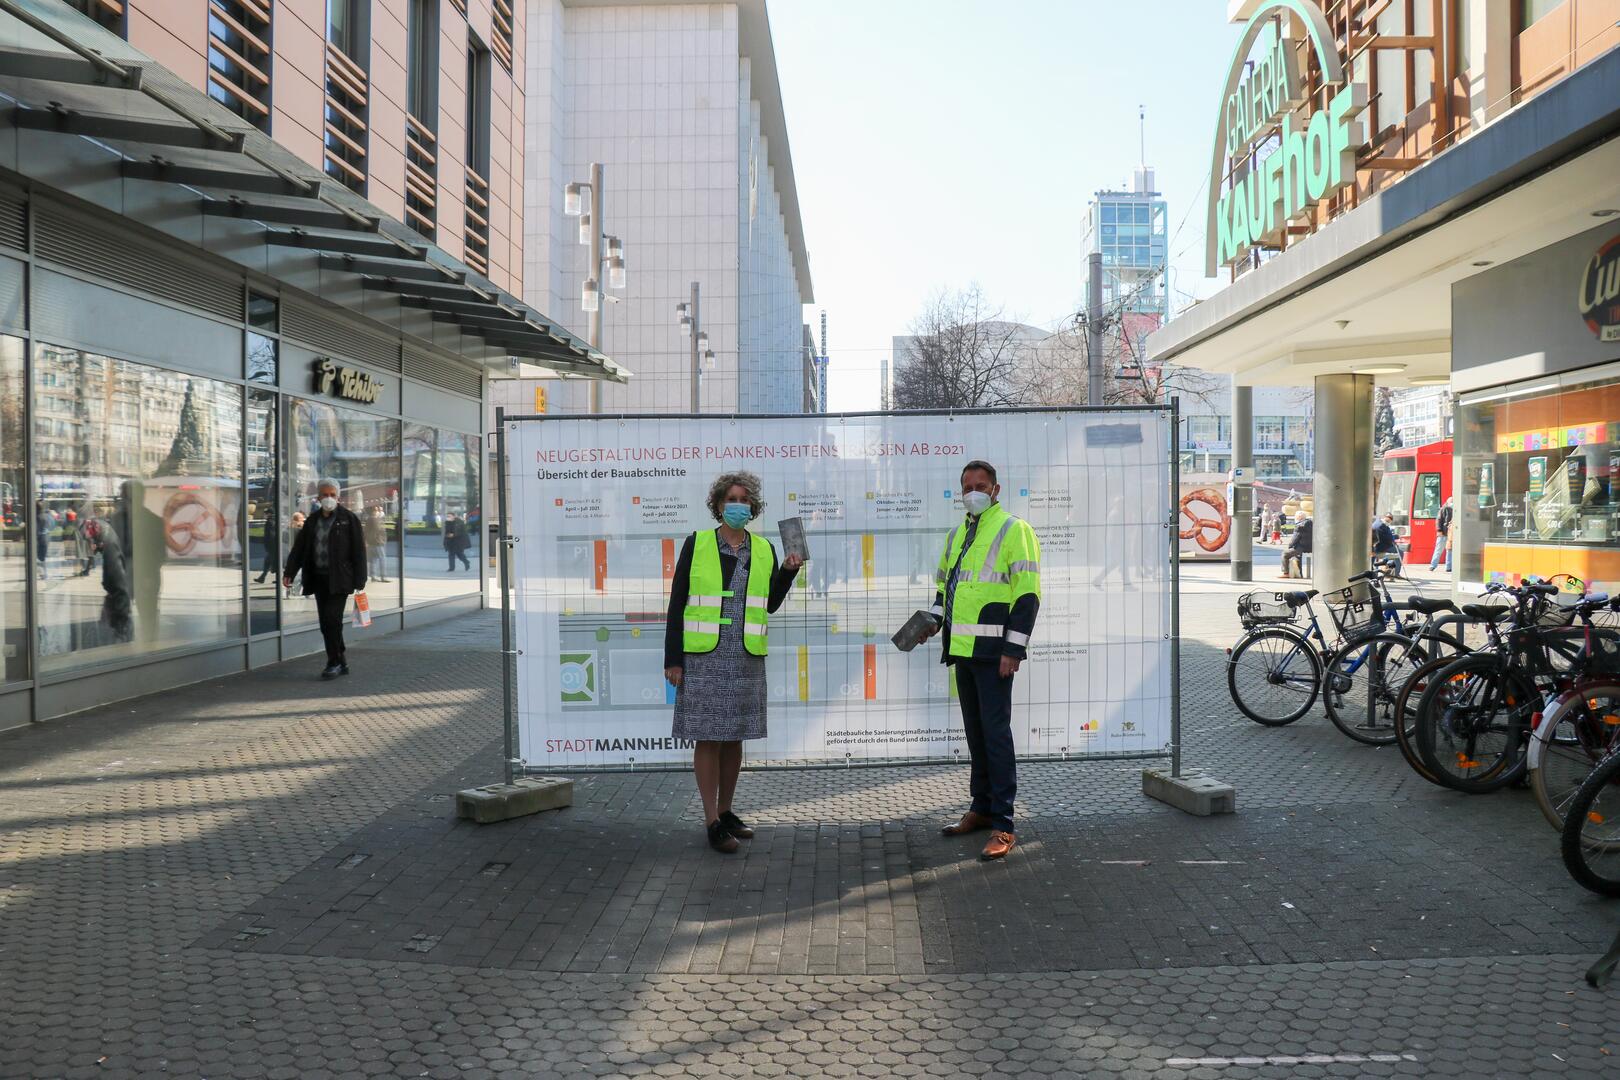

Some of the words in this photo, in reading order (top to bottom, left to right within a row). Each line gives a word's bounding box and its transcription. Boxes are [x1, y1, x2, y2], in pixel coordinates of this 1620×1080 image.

[1226, 38, 1297, 157] GALERIA
[341, 367, 384, 402] Tchibo
[536, 447, 667, 463] NEUGESTALTUNG
[672, 446, 701, 461] DER
[910, 442, 930, 456] AB
[934, 444, 965, 456] 2021
[537, 468, 590, 480] Übersicht
[590, 468, 609, 479] der
[611, 467, 687, 478] Bauabschnitte
[574, 546, 588, 558] P1
[826, 729, 873, 737] Städtebauliche
[874, 728, 942, 736] Sanierungsmaßnahme
